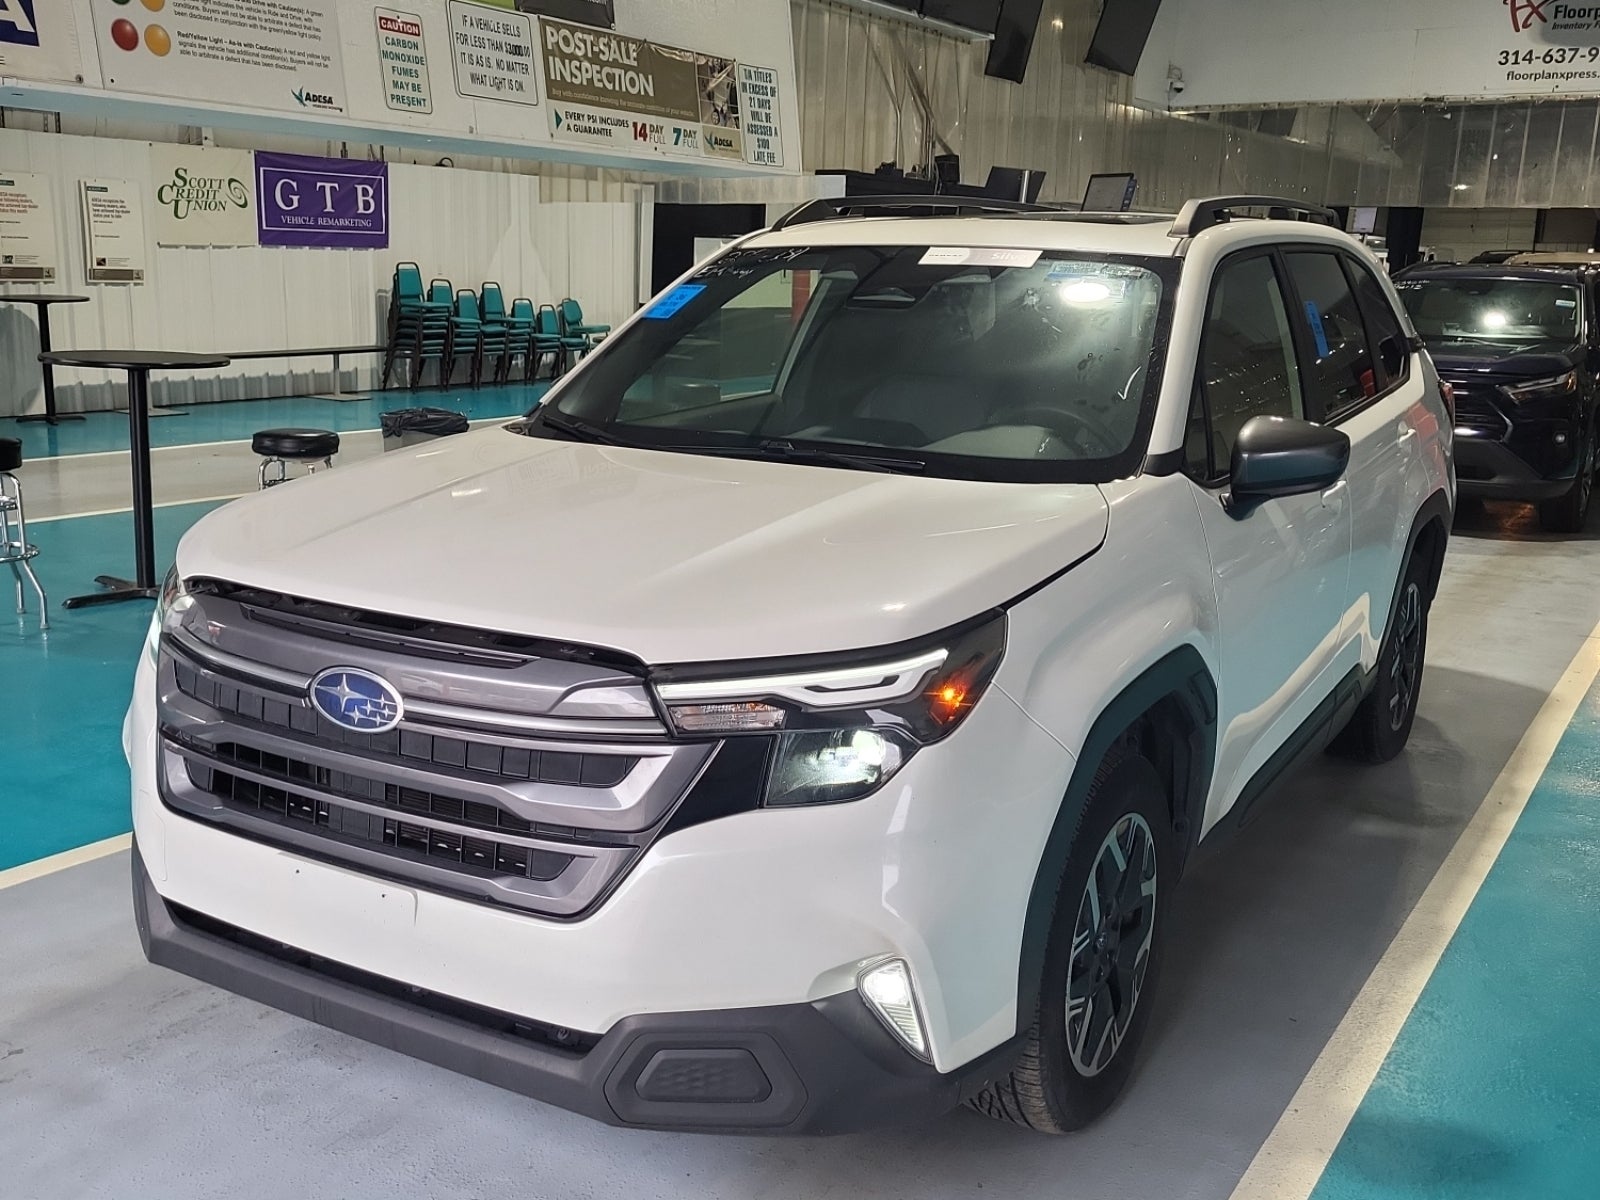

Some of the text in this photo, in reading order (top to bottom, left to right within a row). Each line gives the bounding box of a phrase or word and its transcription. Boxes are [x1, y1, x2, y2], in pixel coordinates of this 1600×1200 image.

[381, 20, 419, 34] CAUTION
[462, 14, 521, 38] IF A VEHICLE SELLS
[1552, 22, 1592, 31] Inventory
[209, 36, 223, 44] Light
[385, 36, 419, 50] CARBON
[456, 32, 469, 46] FOR
[470, 35, 486, 49] LESS
[487, 39, 504, 53] THAN
[546, 26, 637, 67] POST-SALE
[382, 50, 425, 65] MONOXIDE
[1498, 47, 1600, 66] 314-637-9
[461, 52, 466, 64] IT
[468, 53, 474, 65] IS
[476, 55, 484, 67] AS
[496, 58, 505, 70] NO
[506, 60, 529, 76] MATTER
[392, 66, 419, 78] FUMES
[548, 56, 654, 97] INSPECTION
[754, 70, 772, 84] TITLES
[392, 80, 422, 92] MAY BE
[470, 72, 487, 86] WHAT
[489, 76, 506, 89] LIGHT
[508, 79, 514, 91] IS
[741, 82, 776, 97] IN EXCESS OF
[305, 92, 333, 104] ADESA
[391, 94, 426, 107] PRESENT
[749, 96, 771, 110] 21 DAYS
[565, 111, 629, 128] EVERY PSI INCLUDES
[751, 110, 772, 124] WILL BE
[566, 123, 612, 137] A GUARANTEE
[632, 122, 664, 141] 14 DAY
[673, 127, 697, 146] 7 DAY
[747, 123, 778, 137] ASSESSED A
[649, 134, 666, 145] FULL
[683, 139, 698, 149] FULL
[714, 136, 733, 148] ADESA
[754, 150, 776, 163] LATE FEE
[172, 168, 225, 190] SCOTT
[157, 184, 219, 205] CREDIT
[173, 199, 227, 219] UNION
[281, 215, 372, 227] VEHICLE REMARKETING
